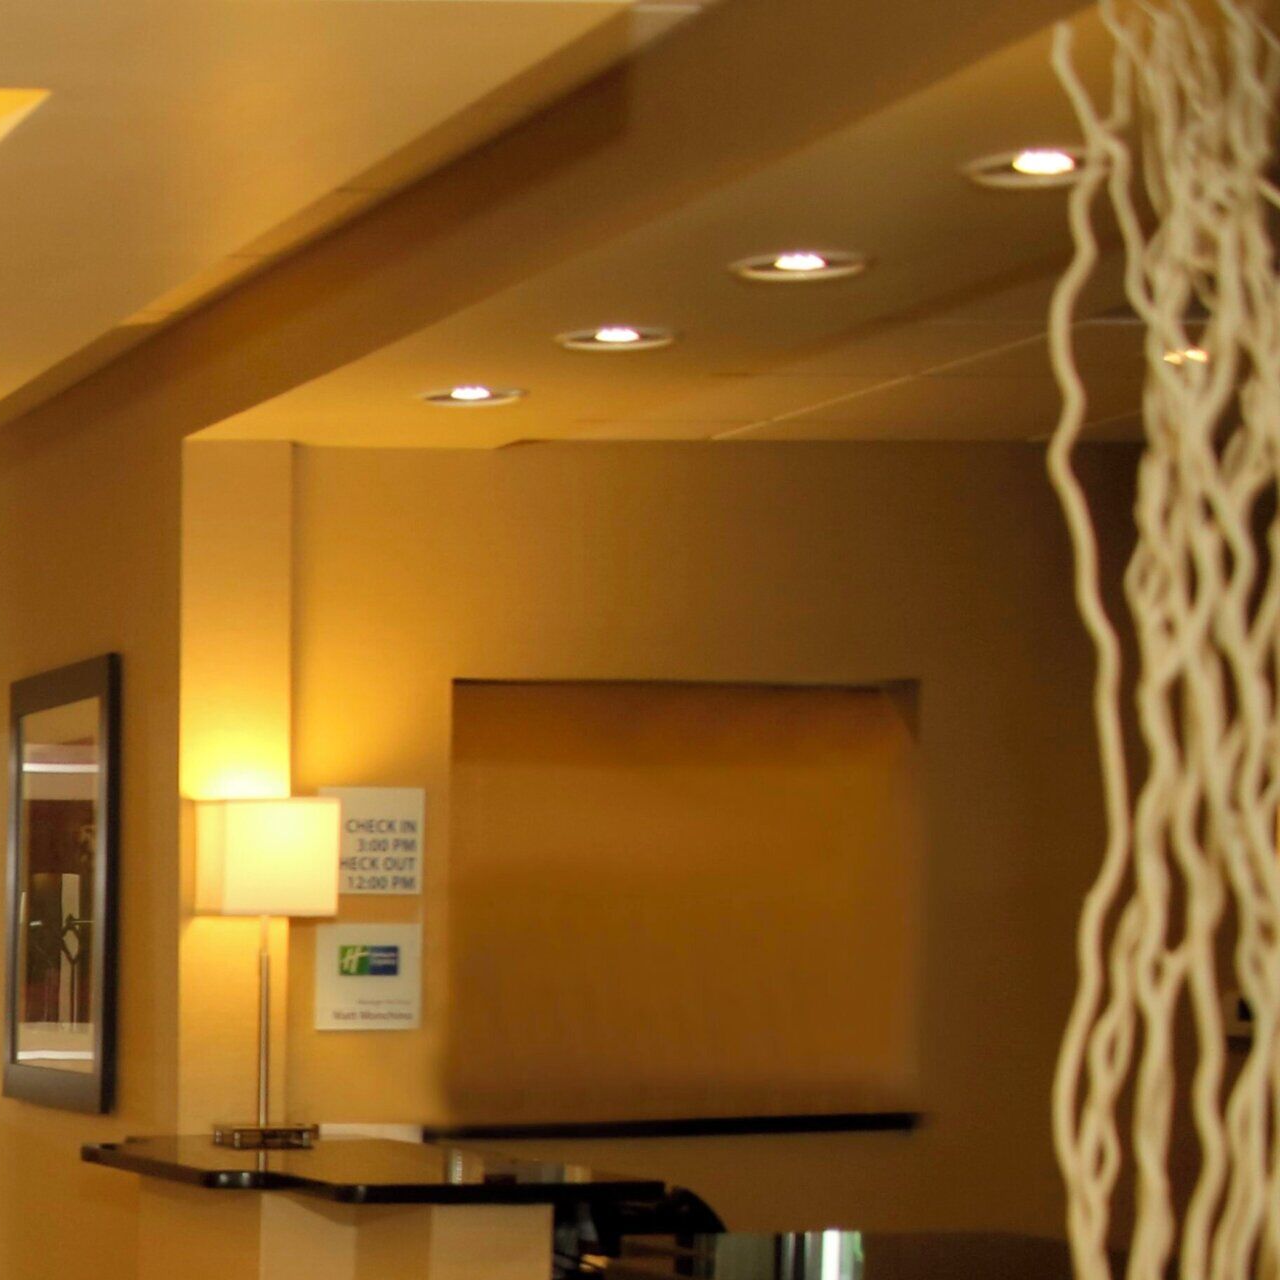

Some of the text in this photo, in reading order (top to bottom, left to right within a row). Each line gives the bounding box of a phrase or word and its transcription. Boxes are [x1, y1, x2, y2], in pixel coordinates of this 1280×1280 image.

[345, 819, 417, 833] CHECK IN
[356, 838, 417, 852] 3:00 PM
[339, 857, 416, 871] HECK OUT
[347, 876, 416, 889] 12:00 PM
